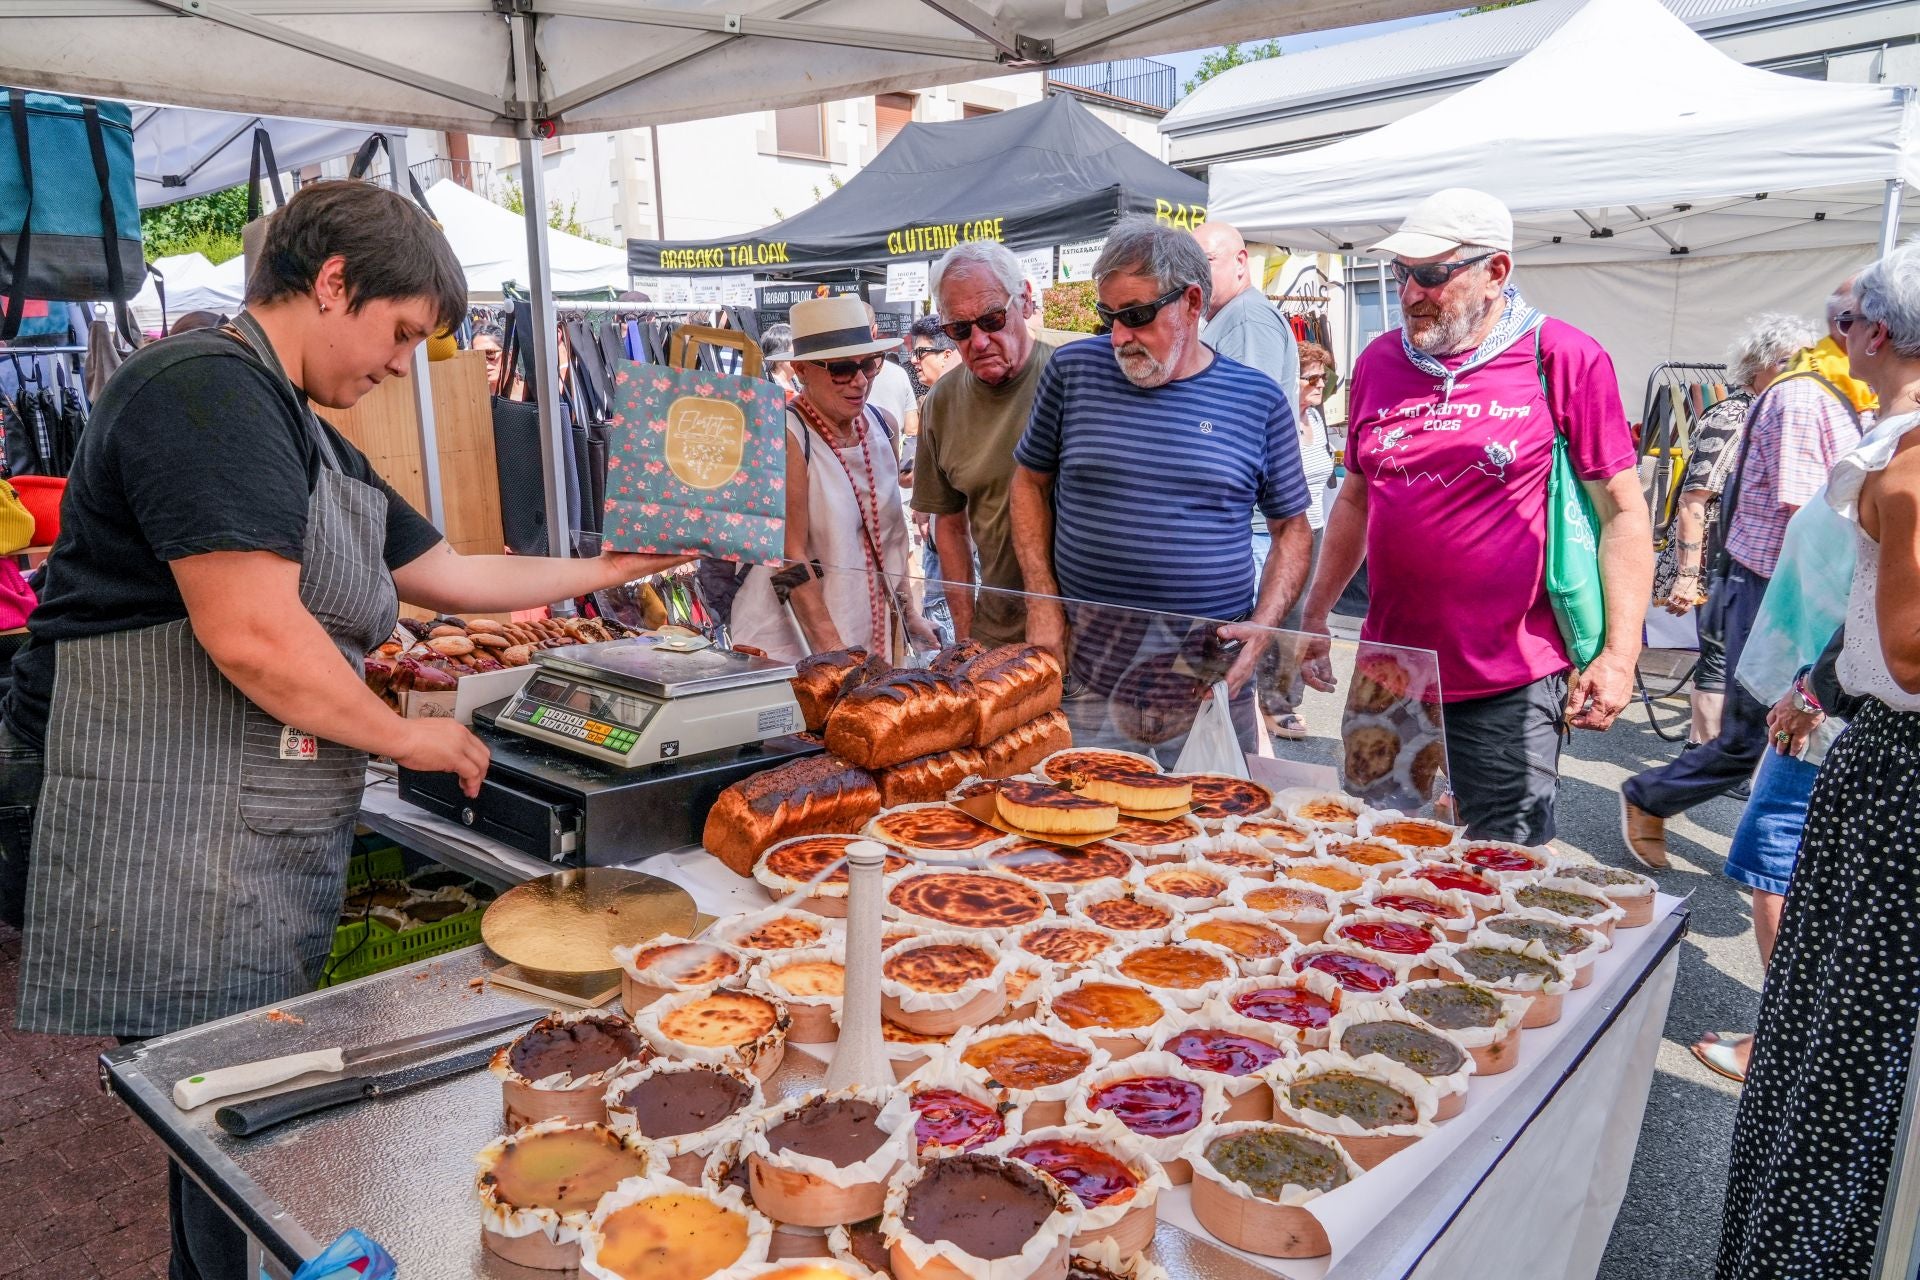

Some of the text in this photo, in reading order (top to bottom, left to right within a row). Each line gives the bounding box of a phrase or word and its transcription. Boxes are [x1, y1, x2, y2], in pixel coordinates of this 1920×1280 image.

[887, 224, 959, 255] GLUTENIK
[660, 241, 790, 269] ARABAKO TALOAK
[763, 290, 789, 305] ARABAKO
[1423, 419, 1462, 431] 2025
[302, 738, 315, 753] 33
